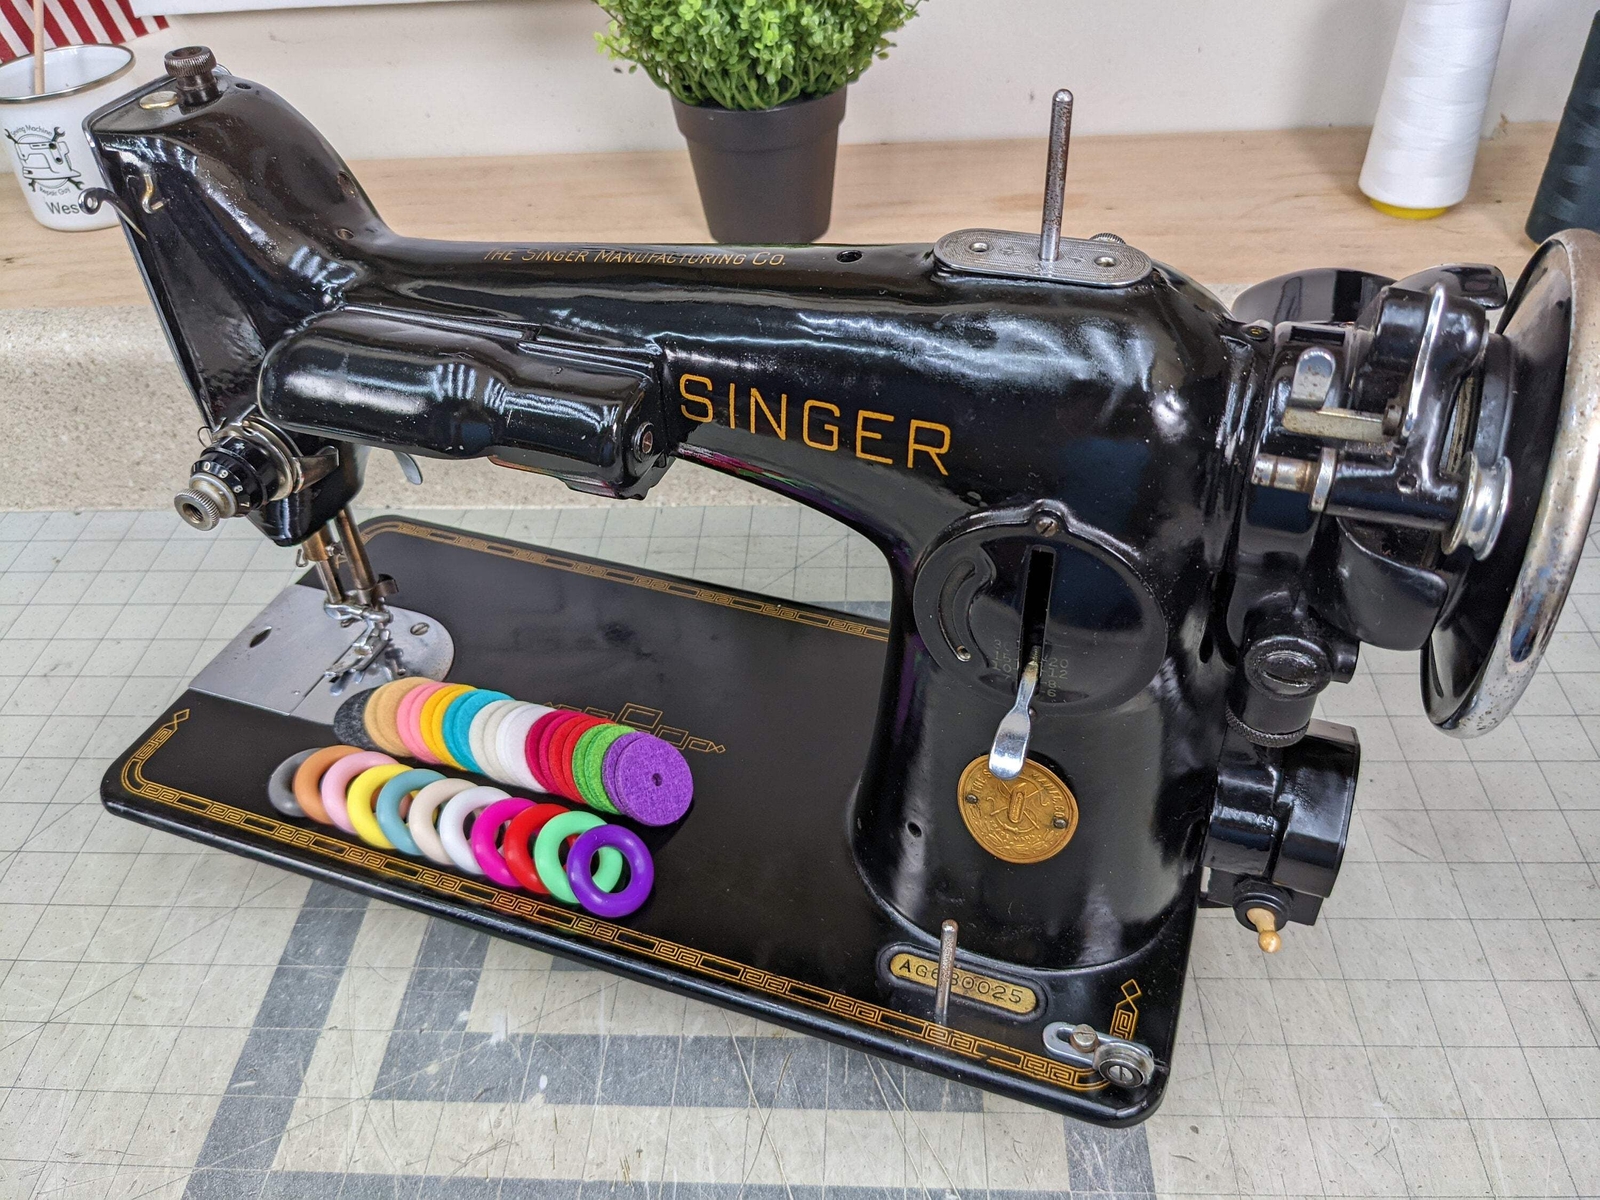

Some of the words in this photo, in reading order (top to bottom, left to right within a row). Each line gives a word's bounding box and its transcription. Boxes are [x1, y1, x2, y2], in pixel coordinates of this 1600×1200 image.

[25, 125, 53, 136] Machine
[58, 187, 71, 196] Guy
[484, 248, 513, 260] THE
[522, 248, 589, 262] SINGER
[593, 249, 746, 265] MANUFACTURING
[751, 251, 786, 266] CO.
[679, 373, 951, 476] SINGER
[1048, 657, 1069, 669] 20
[1048, 667, 1068, 680] 12
